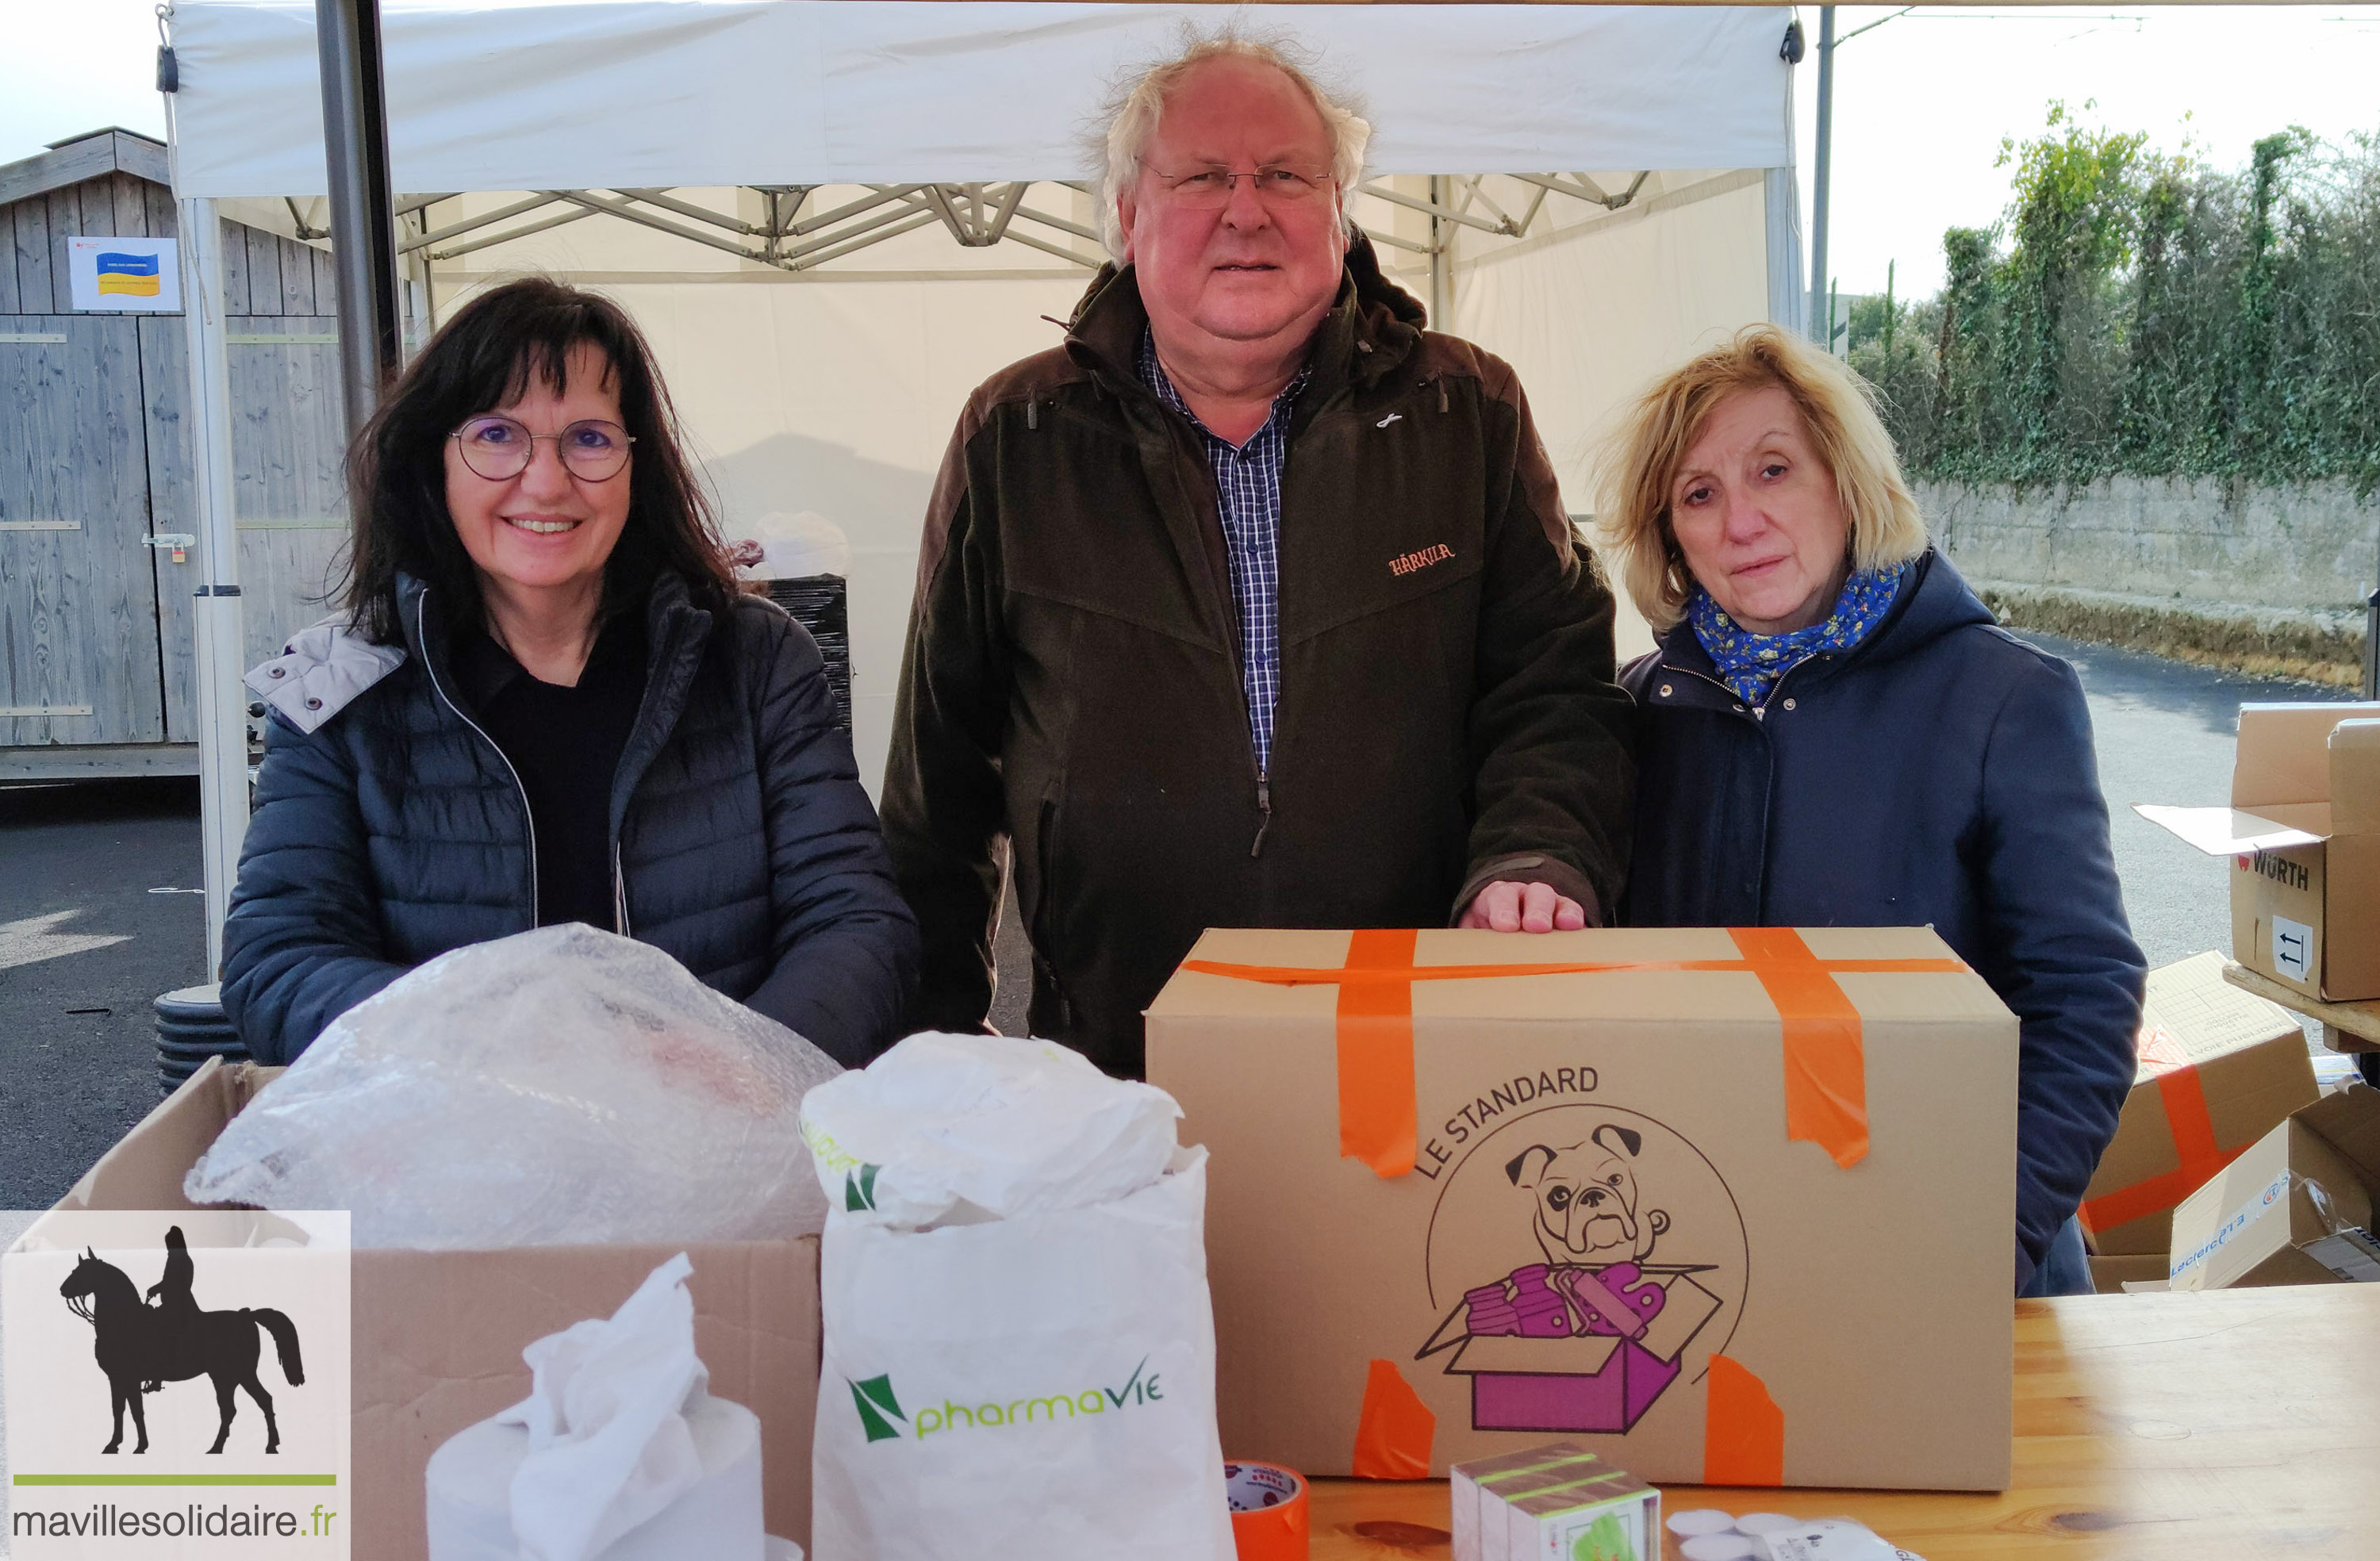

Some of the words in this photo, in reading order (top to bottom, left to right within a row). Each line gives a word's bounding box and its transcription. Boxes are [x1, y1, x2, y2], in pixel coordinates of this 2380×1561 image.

[2254, 850, 2309, 892] WÜRTH
[2195, 1041, 2225, 1054] VOIE
[2225, 1020, 2288, 1045] PUBLIQUE
[1413, 1137, 1453, 1180] LE
[1445, 1066, 1599, 1144] STANDARD
